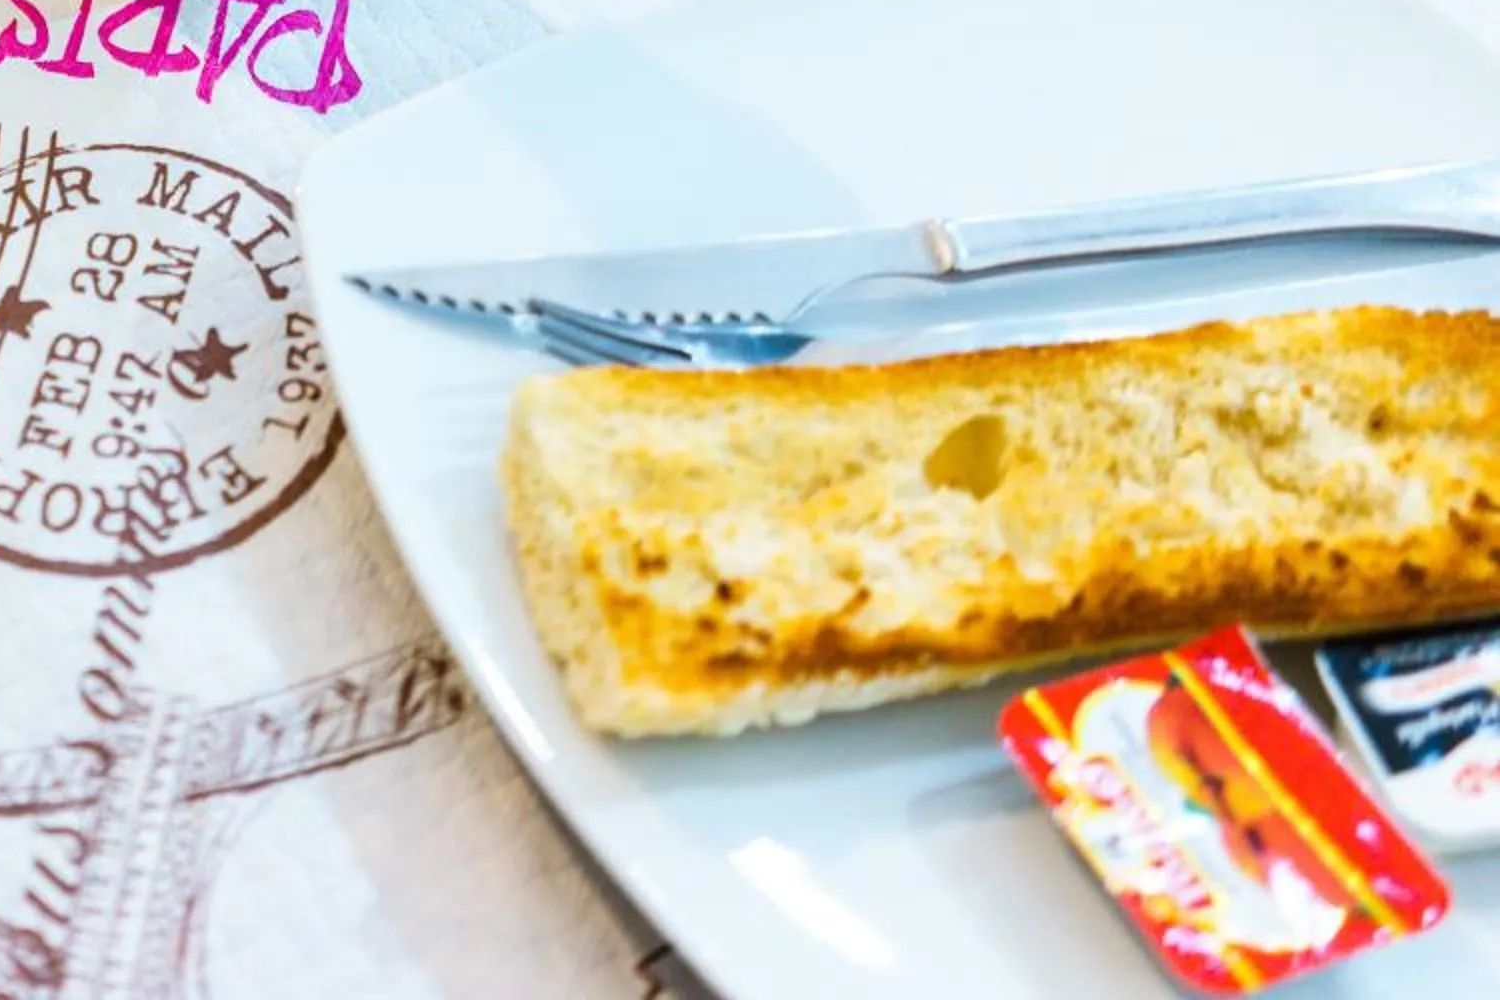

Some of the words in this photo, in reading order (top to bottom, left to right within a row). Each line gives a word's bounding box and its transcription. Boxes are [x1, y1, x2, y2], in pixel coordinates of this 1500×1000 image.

[18, 332, 103, 458] FEB
[71, 231, 138, 303] 28
[91, 351, 163, 459] 9:47
[137, 236, 202, 326] AM
[137, 161, 306, 301] MAIL
[261, 312, 329, 442] 1937
